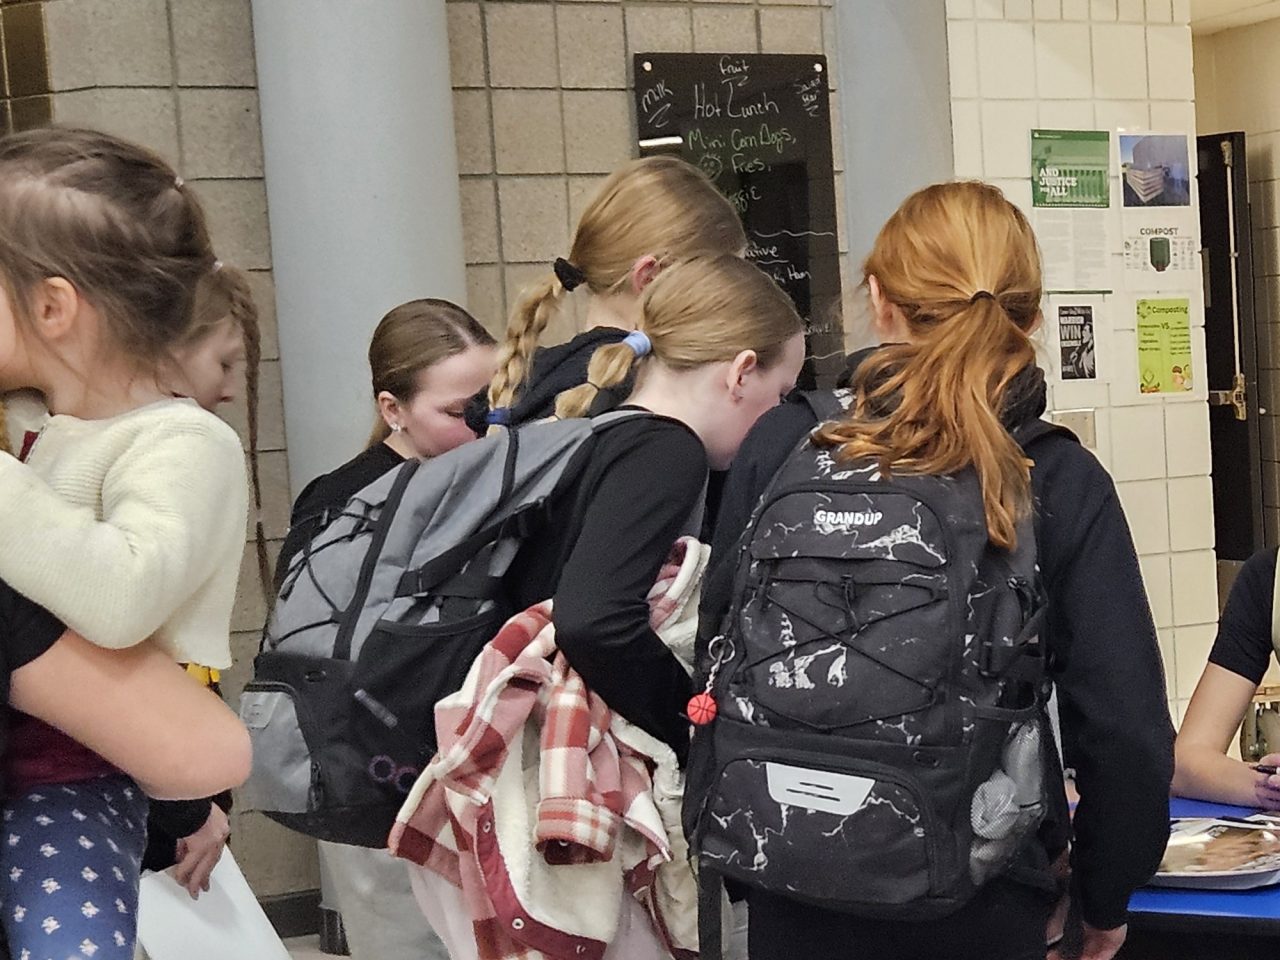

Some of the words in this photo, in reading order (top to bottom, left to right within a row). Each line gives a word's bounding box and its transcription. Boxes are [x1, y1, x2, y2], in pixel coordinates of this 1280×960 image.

[719, 55, 750, 75] Fruit
[642, 80, 673, 113] Milk
[694, 83, 721, 120] Hot
[728, 82, 780, 118] Lunch
[688, 128, 725, 151] Mini
[1040, 167, 1059, 177] AND
[1040, 177, 1077, 187] JUSTICE
[1051, 187, 1068, 197] ALL
[1140, 227, 1179, 236] COMPOST
[1152, 306, 1188, 315] Composting
[1060, 324, 1082, 340] WIN
[815, 510, 883, 526] GRANDUP
